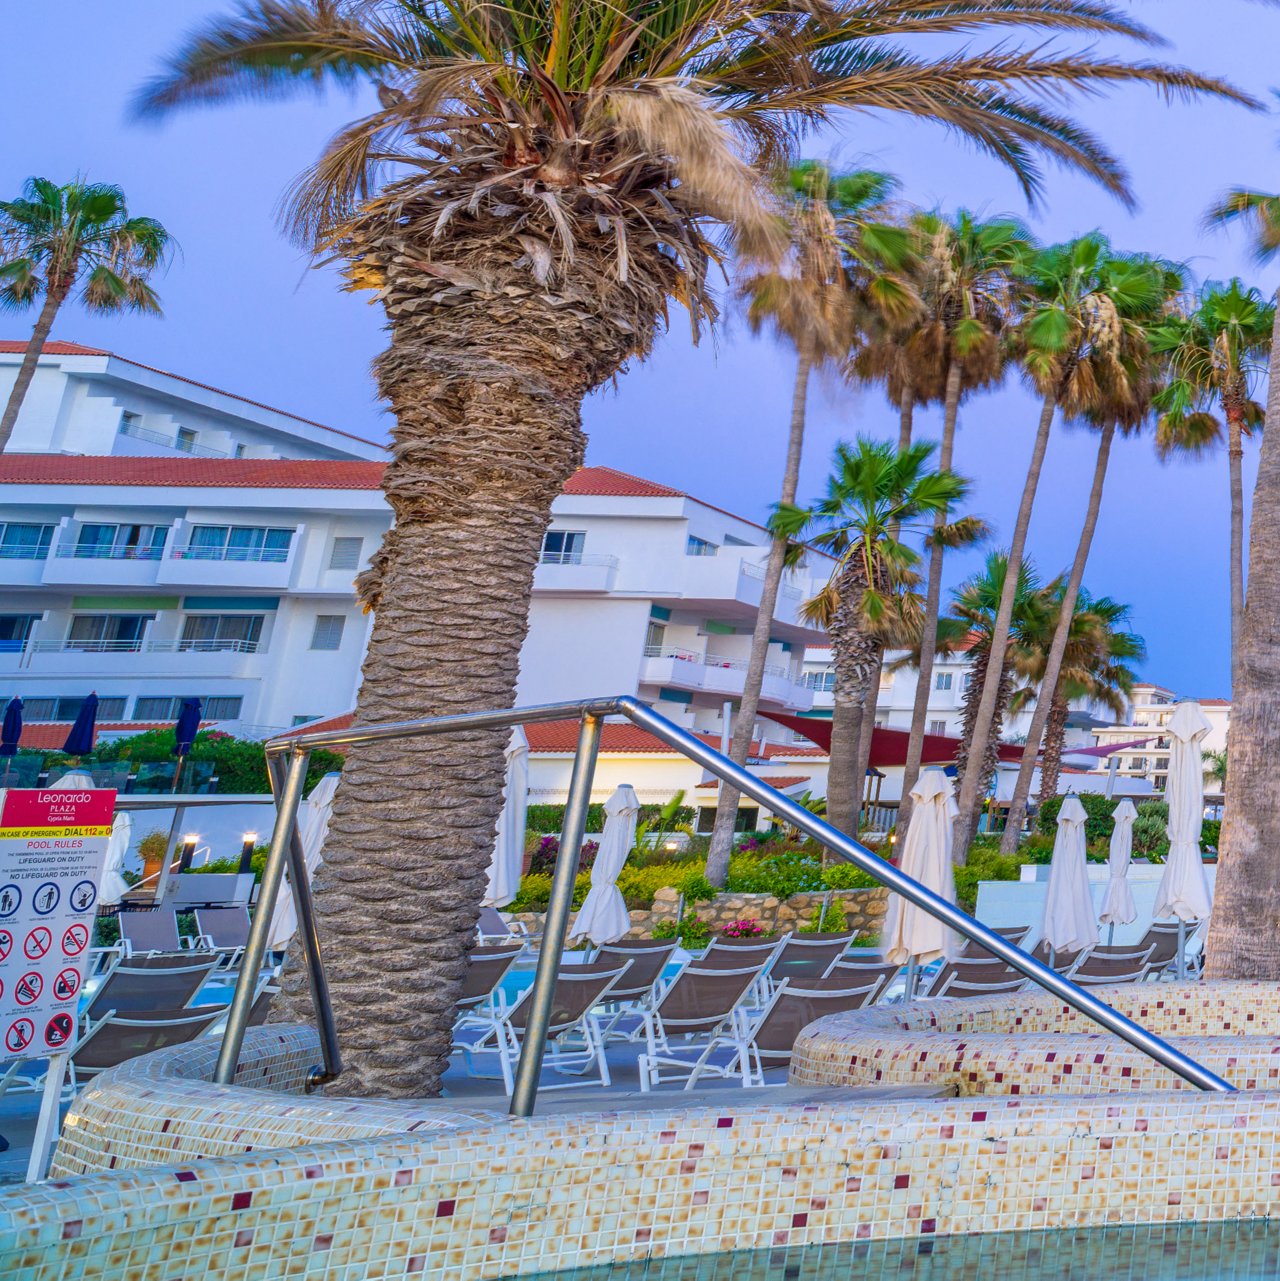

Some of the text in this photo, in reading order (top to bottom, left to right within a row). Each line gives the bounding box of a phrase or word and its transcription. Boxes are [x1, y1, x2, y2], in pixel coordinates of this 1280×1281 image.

[38, 792, 91, 803] Leonardo
[64, 828, 83, 836] DIAL
[27, 840, 83, 849] POOL RULES
